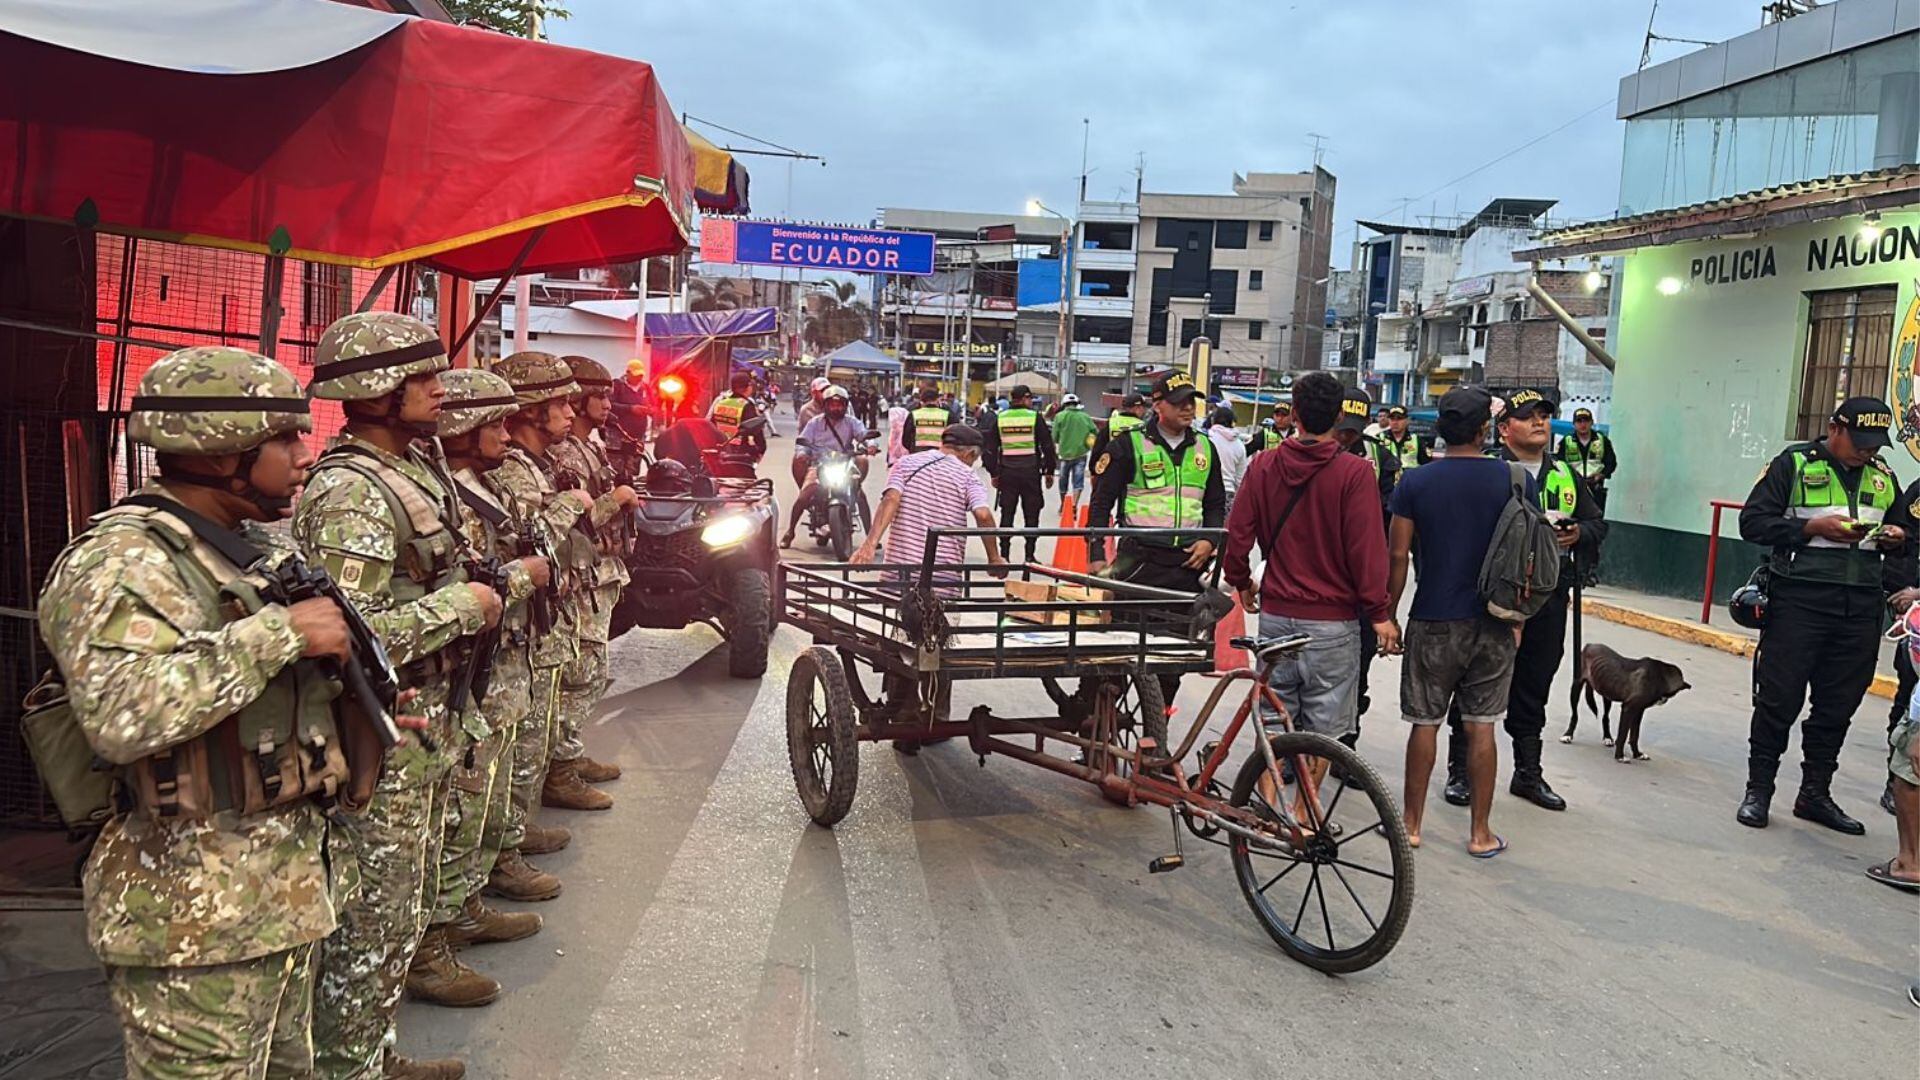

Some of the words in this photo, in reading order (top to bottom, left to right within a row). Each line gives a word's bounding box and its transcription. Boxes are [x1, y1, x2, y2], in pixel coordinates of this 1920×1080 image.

[773, 228, 821, 240] Bienvenido
[831, 232, 839, 241] la
[842, 232, 885, 244] República
[886, 236, 900, 245] del
[771, 242, 899, 268] ECUADOR
[1691, 246, 1776, 285] POLICIA
[1342, 399, 1367, 416] OLICIA
[1511, 389, 1543, 408] POLICIA
